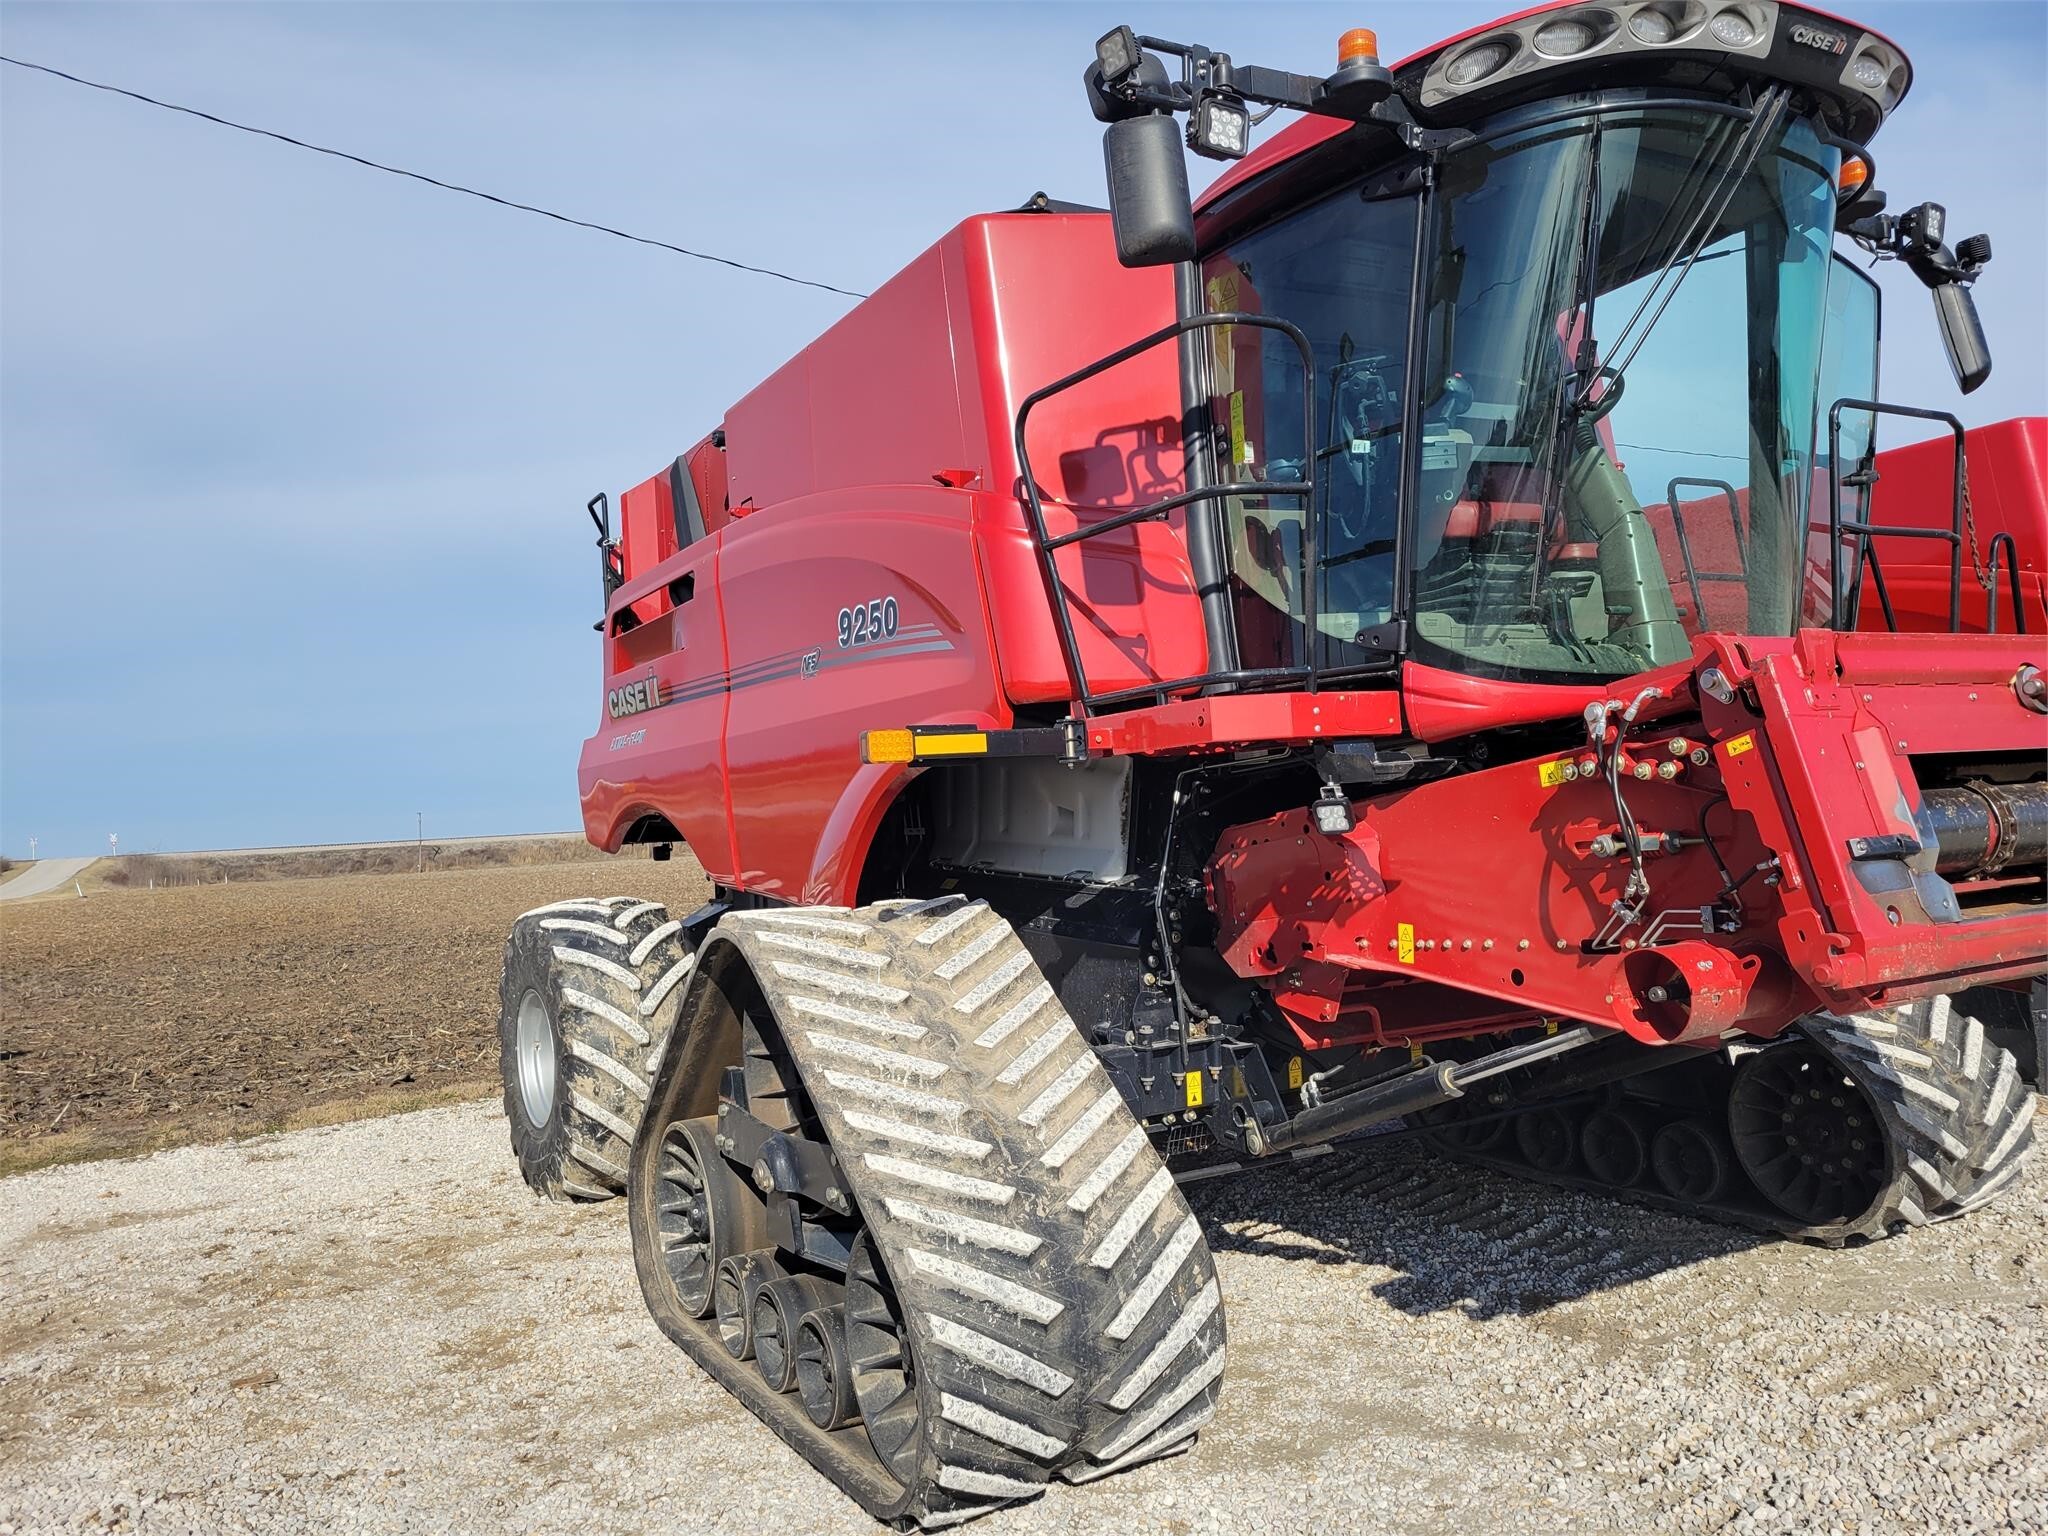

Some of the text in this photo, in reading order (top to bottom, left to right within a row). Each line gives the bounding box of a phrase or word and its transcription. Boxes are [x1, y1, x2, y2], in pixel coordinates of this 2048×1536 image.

[1794, 28, 1833, 51] CASE
[838, 596, 898, 648] 9250
[608, 680, 645, 719] CASE
